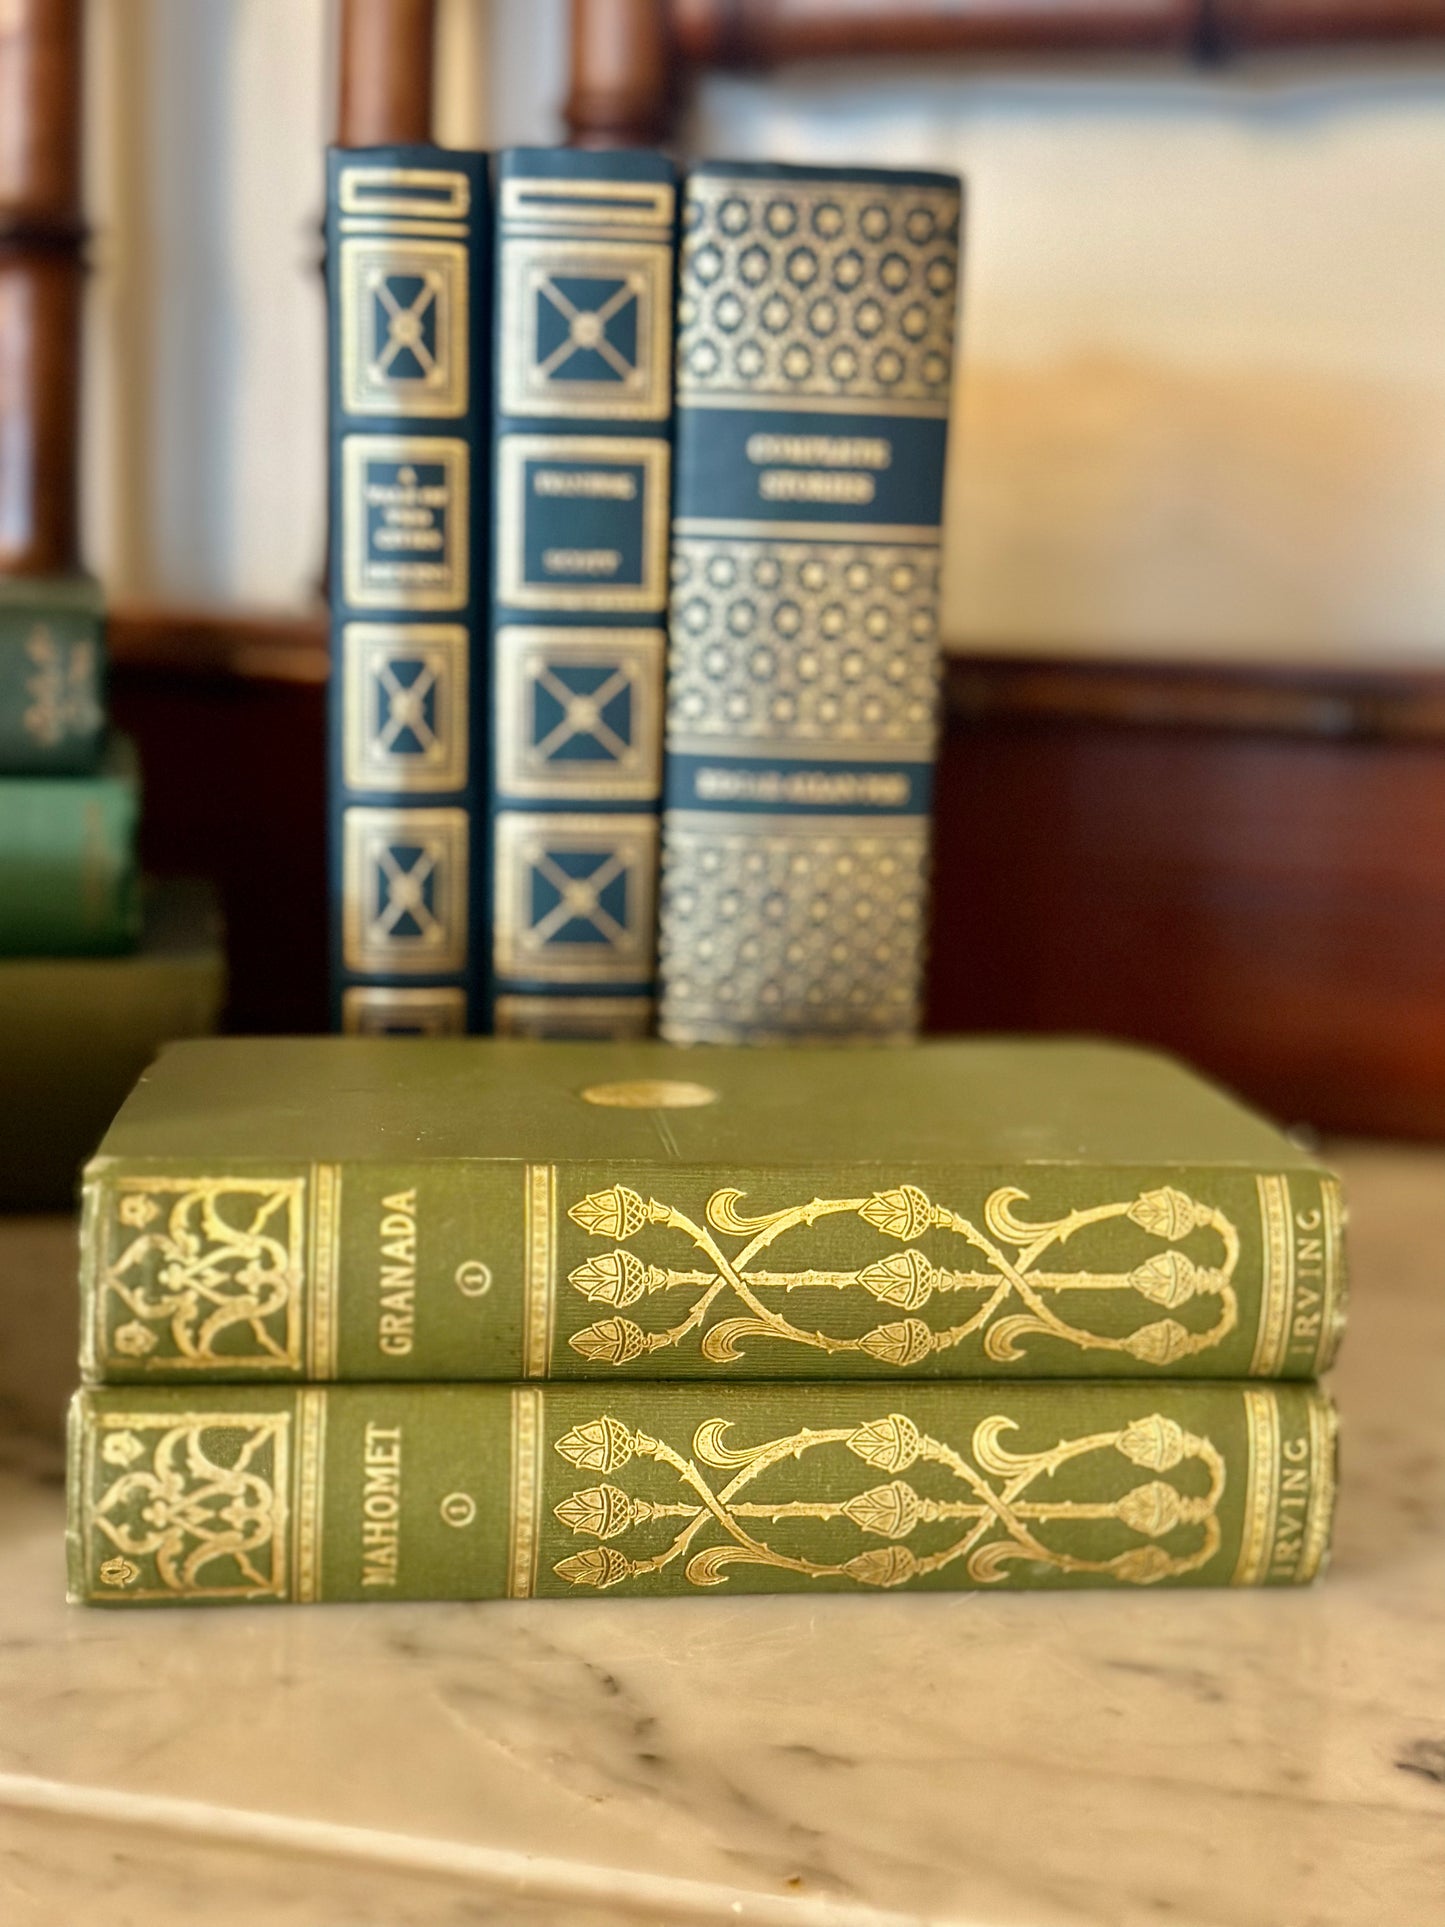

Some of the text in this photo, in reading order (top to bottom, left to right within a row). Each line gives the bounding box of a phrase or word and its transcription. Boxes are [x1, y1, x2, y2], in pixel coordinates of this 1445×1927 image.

[380, 1188, 417, 1356] GRANADA
[1292, 1209, 1323, 1355] IRVING
[362, 1422, 401, 1587] MAHOMET
[1271, 1437, 1309, 1577] IRVING
